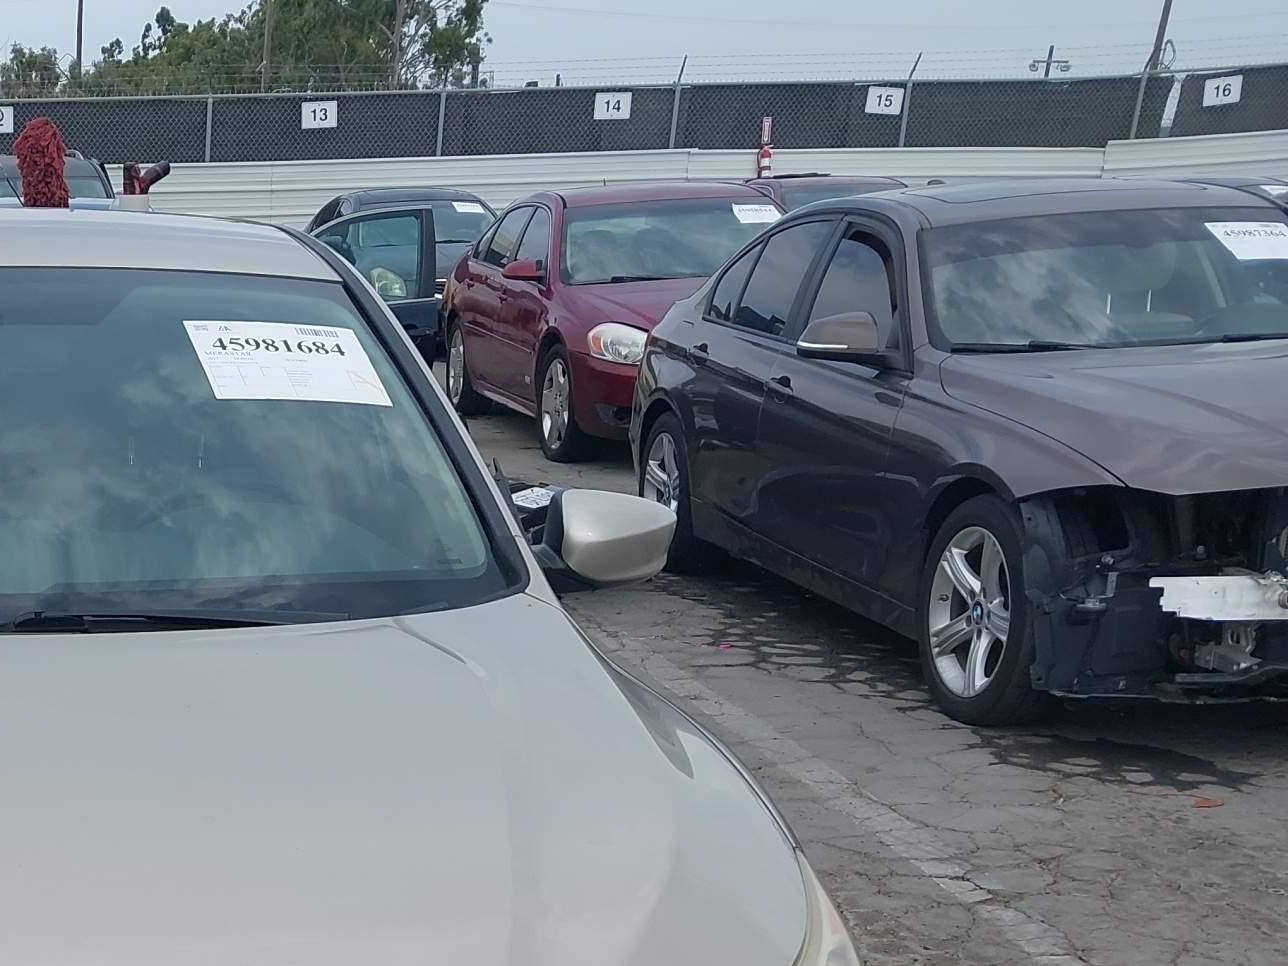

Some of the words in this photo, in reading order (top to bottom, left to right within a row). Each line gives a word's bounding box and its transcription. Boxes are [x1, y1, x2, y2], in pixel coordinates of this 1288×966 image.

[1214, 83, 1233, 99] 16
[604, 99, 622, 113] 14
[876, 94, 894, 109] 15
[310, 108, 328, 122] 13
[212, 337, 346, 357] 45981684
